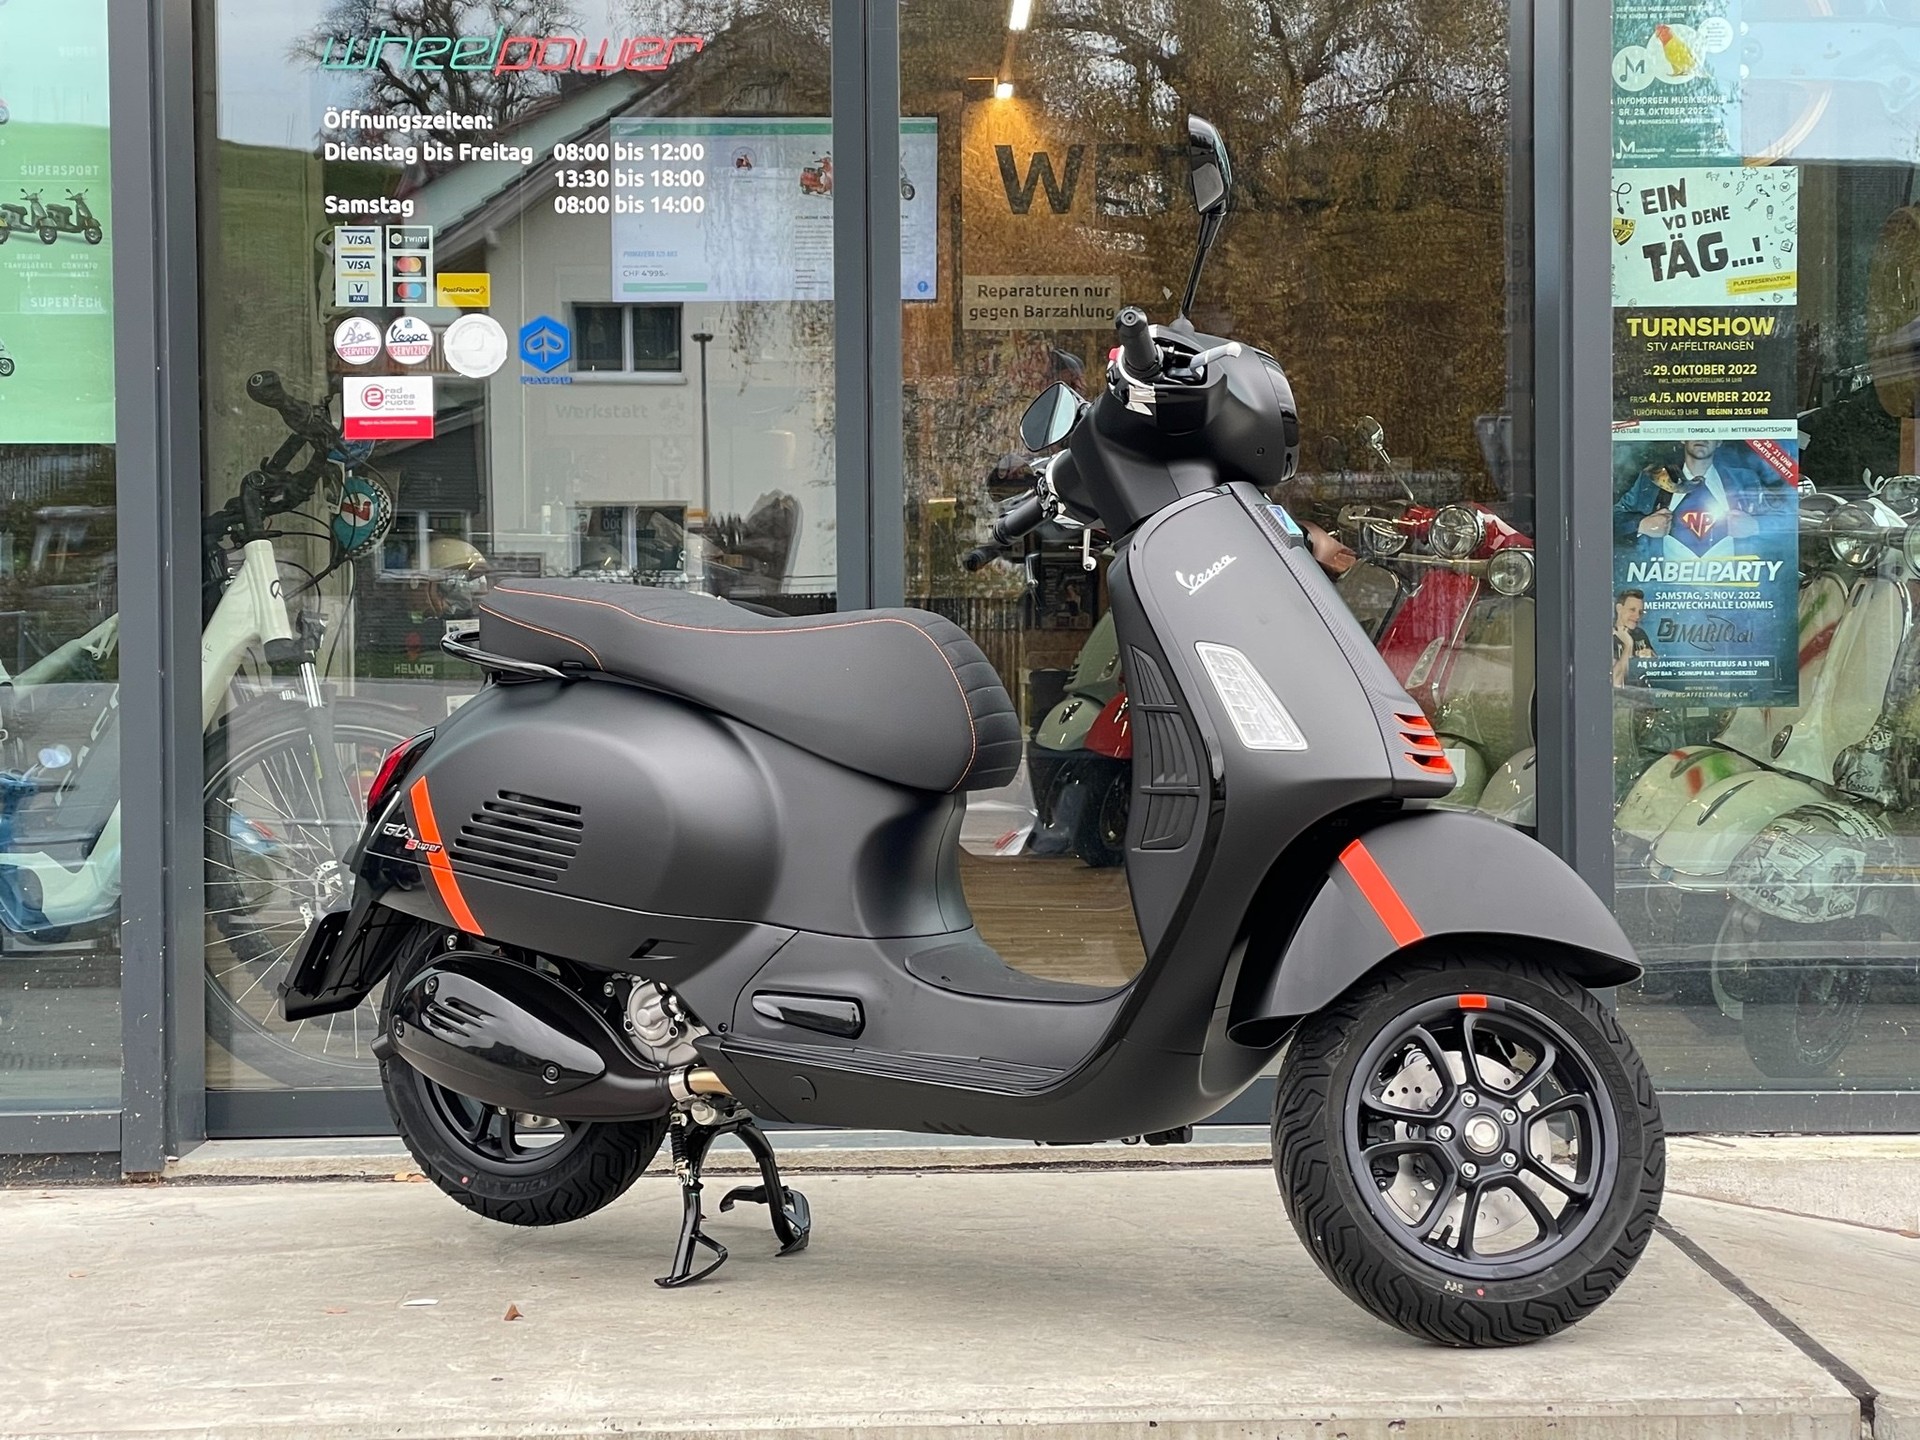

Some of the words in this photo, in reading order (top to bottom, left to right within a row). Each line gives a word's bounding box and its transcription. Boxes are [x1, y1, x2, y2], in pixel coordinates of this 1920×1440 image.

[321, 25, 704, 77] wheelpower
[1617, 97, 1669, 105] INFOMORGEN
[1671, 95, 1727, 104] MUSIKSCHULE
[1648, 107, 1686, 115] OKTOBER
[1687, 106, 1709, 115] 2022
[324, 106, 494, 132] Öffnungszeiten:
[324, 143, 419, 165] Dienstag
[423, 142, 454, 162] bis
[458, 142, 534, 165] Freitag
[553, 143, 609, 162] 08:00
[614, 142, 644, 162] bis
[650, 143, 705, 162] 12:00
[20, 164, 100, 176] SUPERSPORT
[554, 170, 609, 188] 13:30
[614, 169, 644, 188] bis
[650, 170, 705, 188] 18:00
[1640, 177, 1688, 215] EIN
[324, 195, 415, 217] Samstag
[554, 196, 609, 214] 08:00
[614, 195, 644, 214] bis
[650, 196, 705, 214] 14:00
[1662, 214, 1687, 231] VO
[1691, 205, 1731, 226] DENE
[346, 235, 372, 245] VISA
[346, 260, 371, 270] VISA
[977, 284, 1079, 301] Reparaturen
[1084, 285, 1111, 298] nur
[30, 297, 101, 308] SUPERTECH
[968, 307, 1020, 321] gegen
[1023, 304, 1115, 321] Barzahlung
[1626, 316, 1775, 338] TURNSHOW
[389, 324, 430, 345] Vespa
[342, 347, 375, 357] SERVIZIO
[392, 347, 428, 357] SERVIZIO
[1646, 342, 1668, 352] STV
[1670, 341, 1755, 351] AFFELTRANGEN
[1653, 365, 1671, 376] 29.
[1672, 364, 1726, 376] OKTOBER
[1728, 364, 1758, 375] 2022
[1649, 392, 1674, 403] 4./5.
[1675, 391, 1739, 402] NOVEMBER
[1741, 391, 1771, 402] 2022
[555, 403, 649, 419] Werkstatt
[1632, 408, 1676, 416] TÜRÖFFNUNG
[1706, 408, 1733, 416] BEGINN
[1753, 407, 1769, 415] UHR
[1752, 440, 1772, 459] GRATIS
[1769, 456, 1794, 479] EINTRITT
[1780, 455, 1793, 468] UHR
[1175, 555, 1238, 596] Vespa
[1627, 557, 1784, 583] NÄBELPARTY
[1655, 591, 1702, 601] SAMSTAG,
[1738, 591, 1761, 600] 2022
[1644, 601, 1734, 610] MEHRZWECKHALLE
[1735, 600, 1774, 610] LOMMIS
[393, 663, 434, 675] HELMO
[1637, 661, 1647, 669] AB
